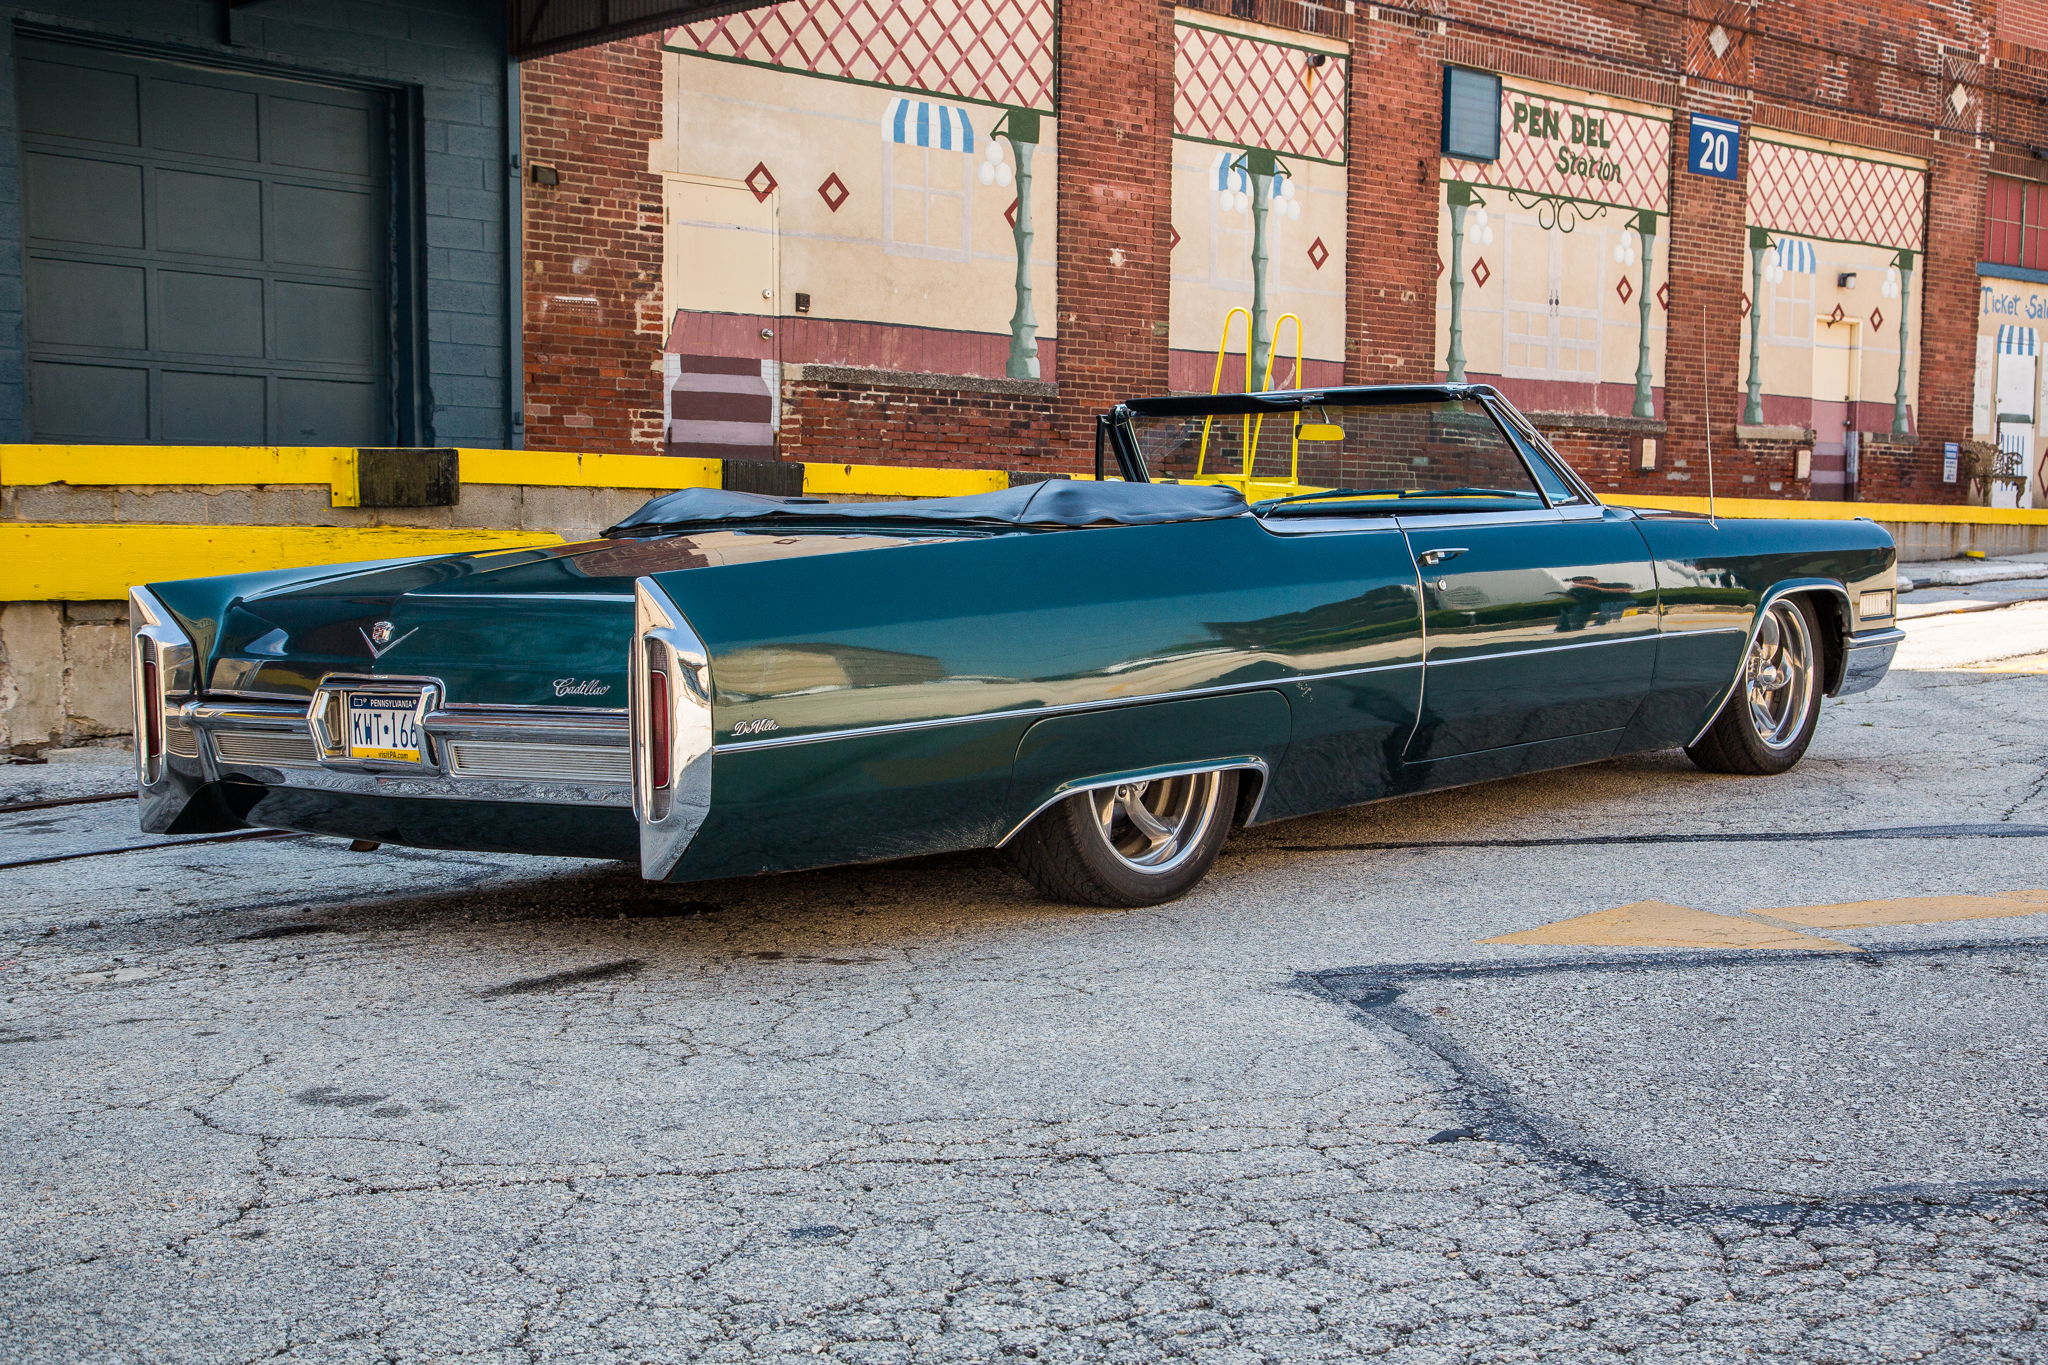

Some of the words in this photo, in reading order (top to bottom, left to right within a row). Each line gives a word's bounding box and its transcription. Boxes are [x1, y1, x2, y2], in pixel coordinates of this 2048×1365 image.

[1513, 101, 1559, 141] PEN
[1571, 114, 1610, 149] DEL
[1555, 145, 1621, 183] Station
[1699, 131, 1729, 173] 20
[1979, 286, 2020, 316] Ticket
[552, 677, 611, 697] Cadillac
[370, 699, 413, 708] PENNSYLVANIA
[730, 718, 780, 736] DeVille
[378, 751, 409, 760] visitPA.com
